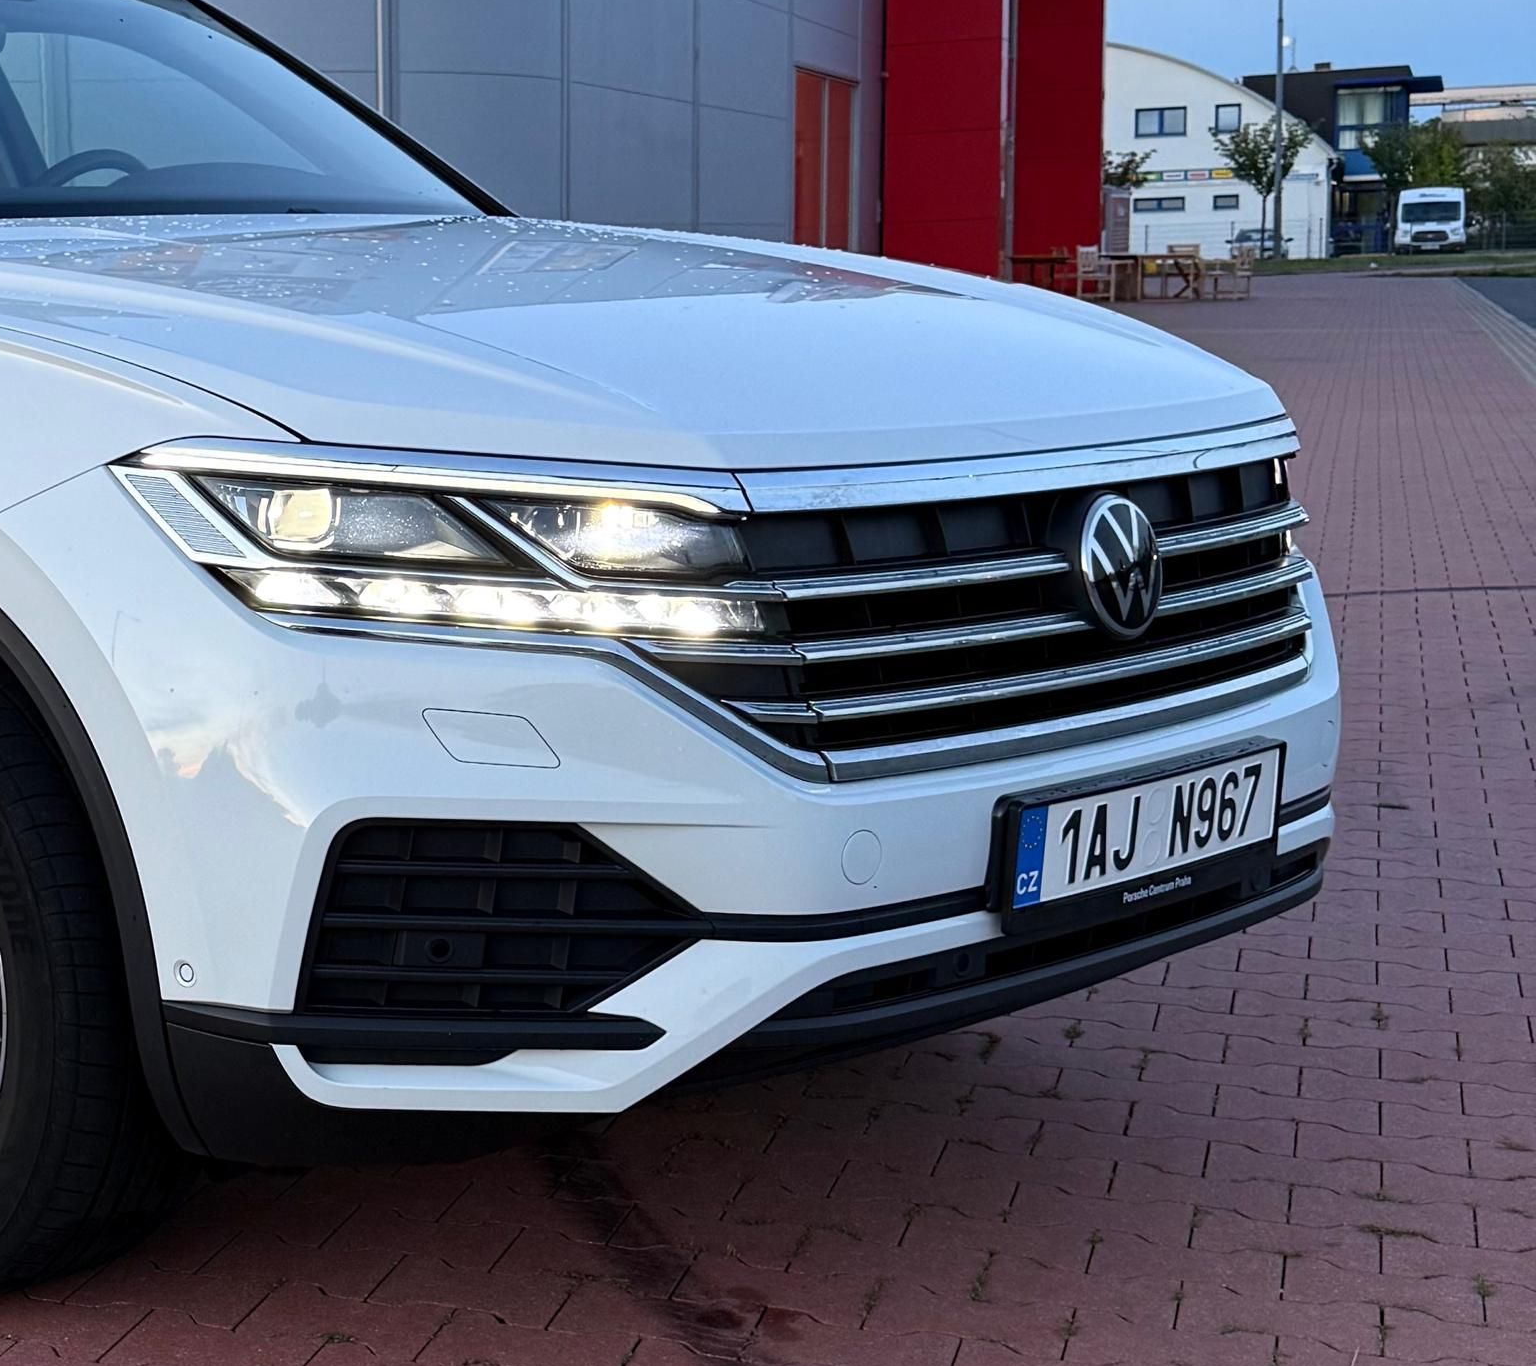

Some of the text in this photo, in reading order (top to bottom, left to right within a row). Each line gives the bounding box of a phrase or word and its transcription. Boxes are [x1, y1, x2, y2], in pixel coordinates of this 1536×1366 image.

[1059, 762, 1262, 885] 1AJ N967
[1016, 870, 1040, 895] CZ
